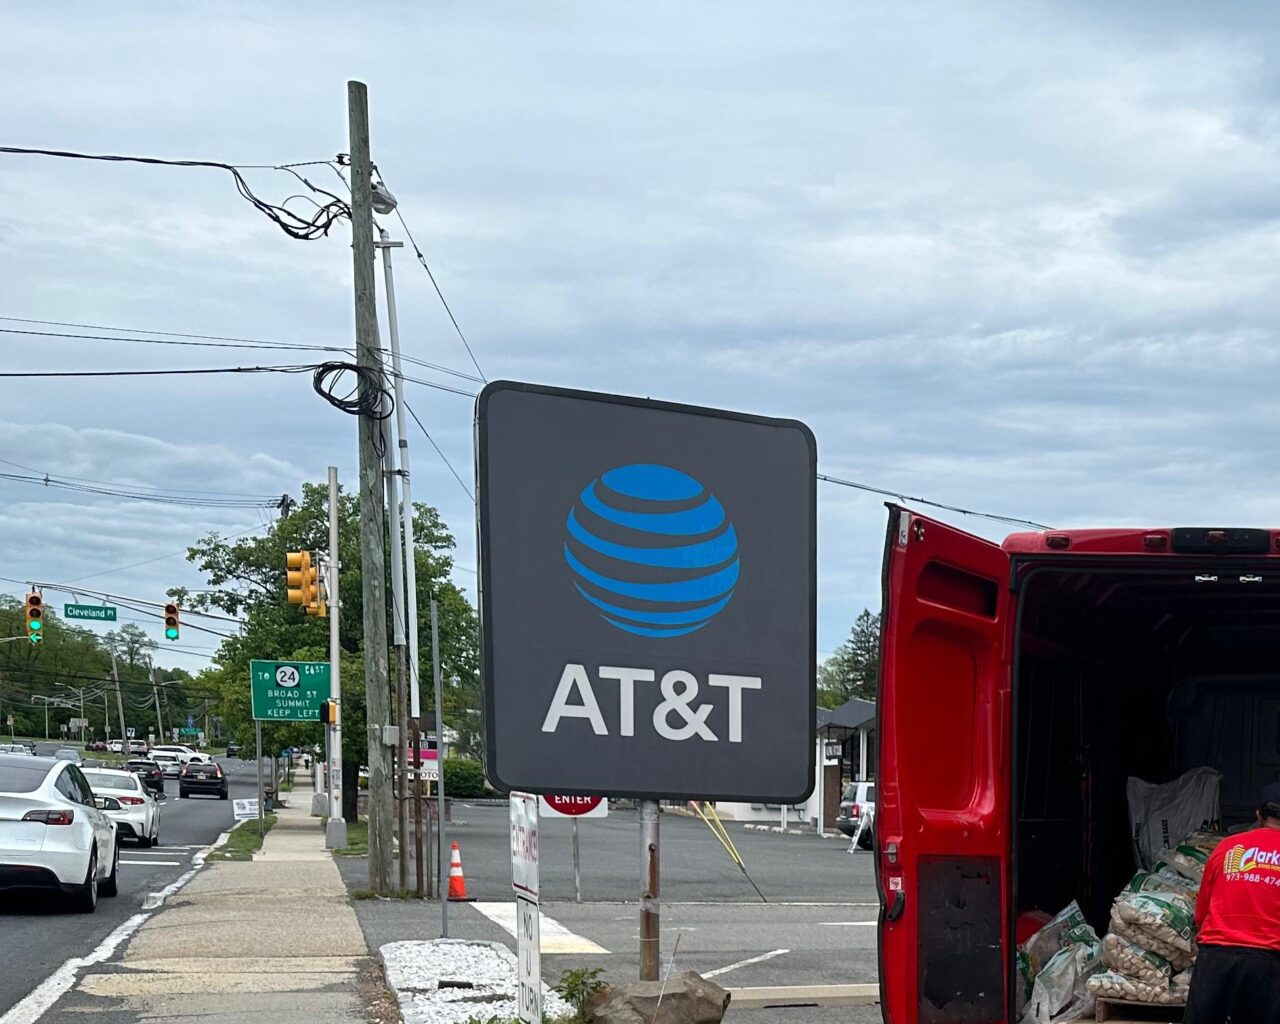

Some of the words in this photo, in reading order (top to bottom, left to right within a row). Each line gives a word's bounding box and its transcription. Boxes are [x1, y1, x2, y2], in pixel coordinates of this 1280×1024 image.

[67, 606, 105, 618] Cleveland
[107, 609, 114, 617] Pl
[258, 672, 270, 680] TO
[279, 670, 296, 683] 24
[304, 665, 325, 675] EAST
[267, 689, 299, 698] BROAD
[306, 690, 317, 699] ST
[276, 699, 310, 708] SUMMIT
[541, 663, 762, 743] AT&T
[267, 708, 291, 717] KEEP
[297, 709, 320, 718] LEFT
[554, 795, 592, 805] ENTER
[523, 910, 533, 941] NO
[525, 947, 532, 977] U
[520, 981, 540, 1018] TURN
